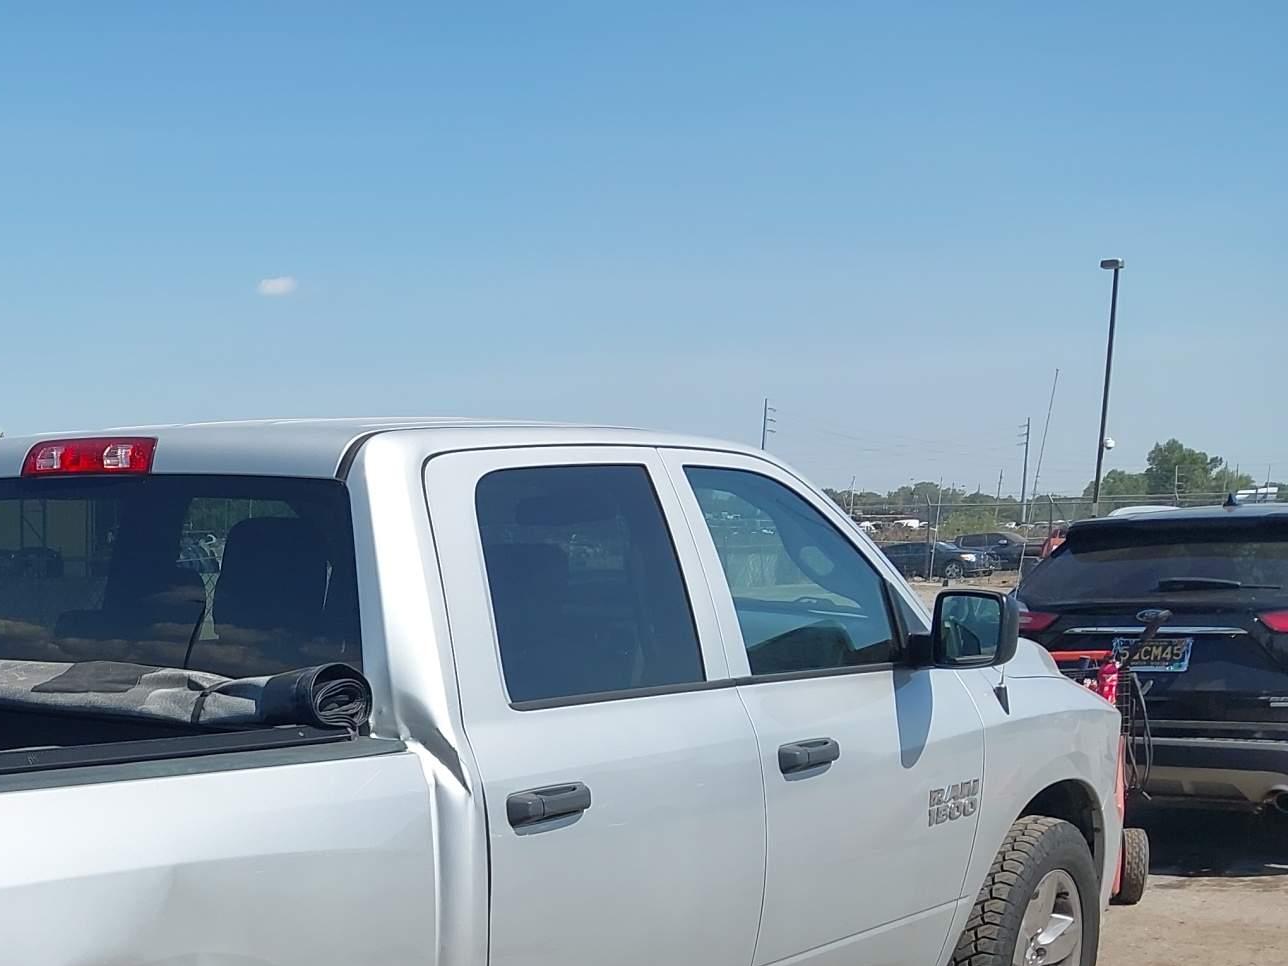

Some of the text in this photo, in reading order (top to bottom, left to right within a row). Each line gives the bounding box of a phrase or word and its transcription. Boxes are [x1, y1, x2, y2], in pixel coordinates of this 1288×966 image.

[1120, 646, 1183, 660] 5CM45
[929, 778, 980, 806] RAM
[927, 797, 977, 827] 1500
